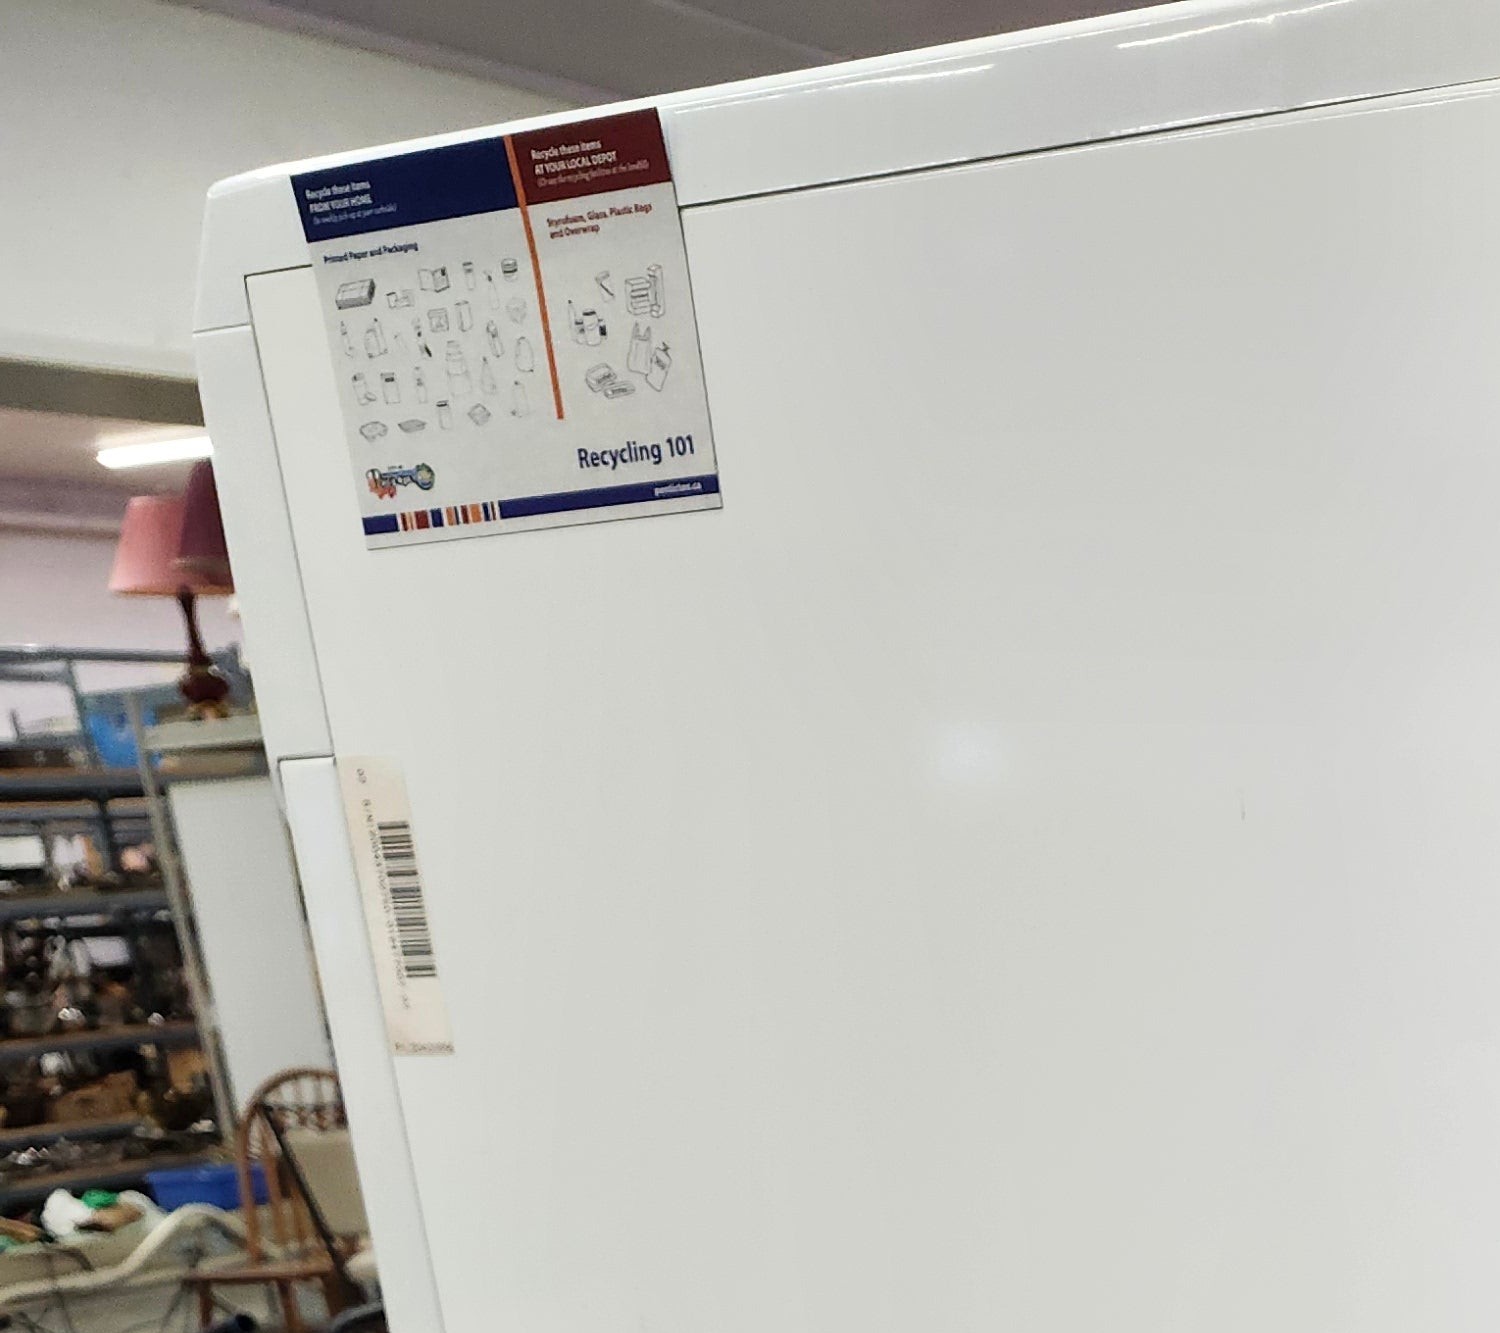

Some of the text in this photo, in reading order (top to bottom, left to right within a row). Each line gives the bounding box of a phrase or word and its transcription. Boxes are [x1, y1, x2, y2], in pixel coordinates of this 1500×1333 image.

[531, 140, 602, 160] Recycle these items
[535, 151, 617, 175] AT YOUR LOCAL DEPOT
[609, 206, 633, 217] Plastic
[550, 224, 600, 239] and Overwrap
[577, 434, 695, 470] Recycling 101
